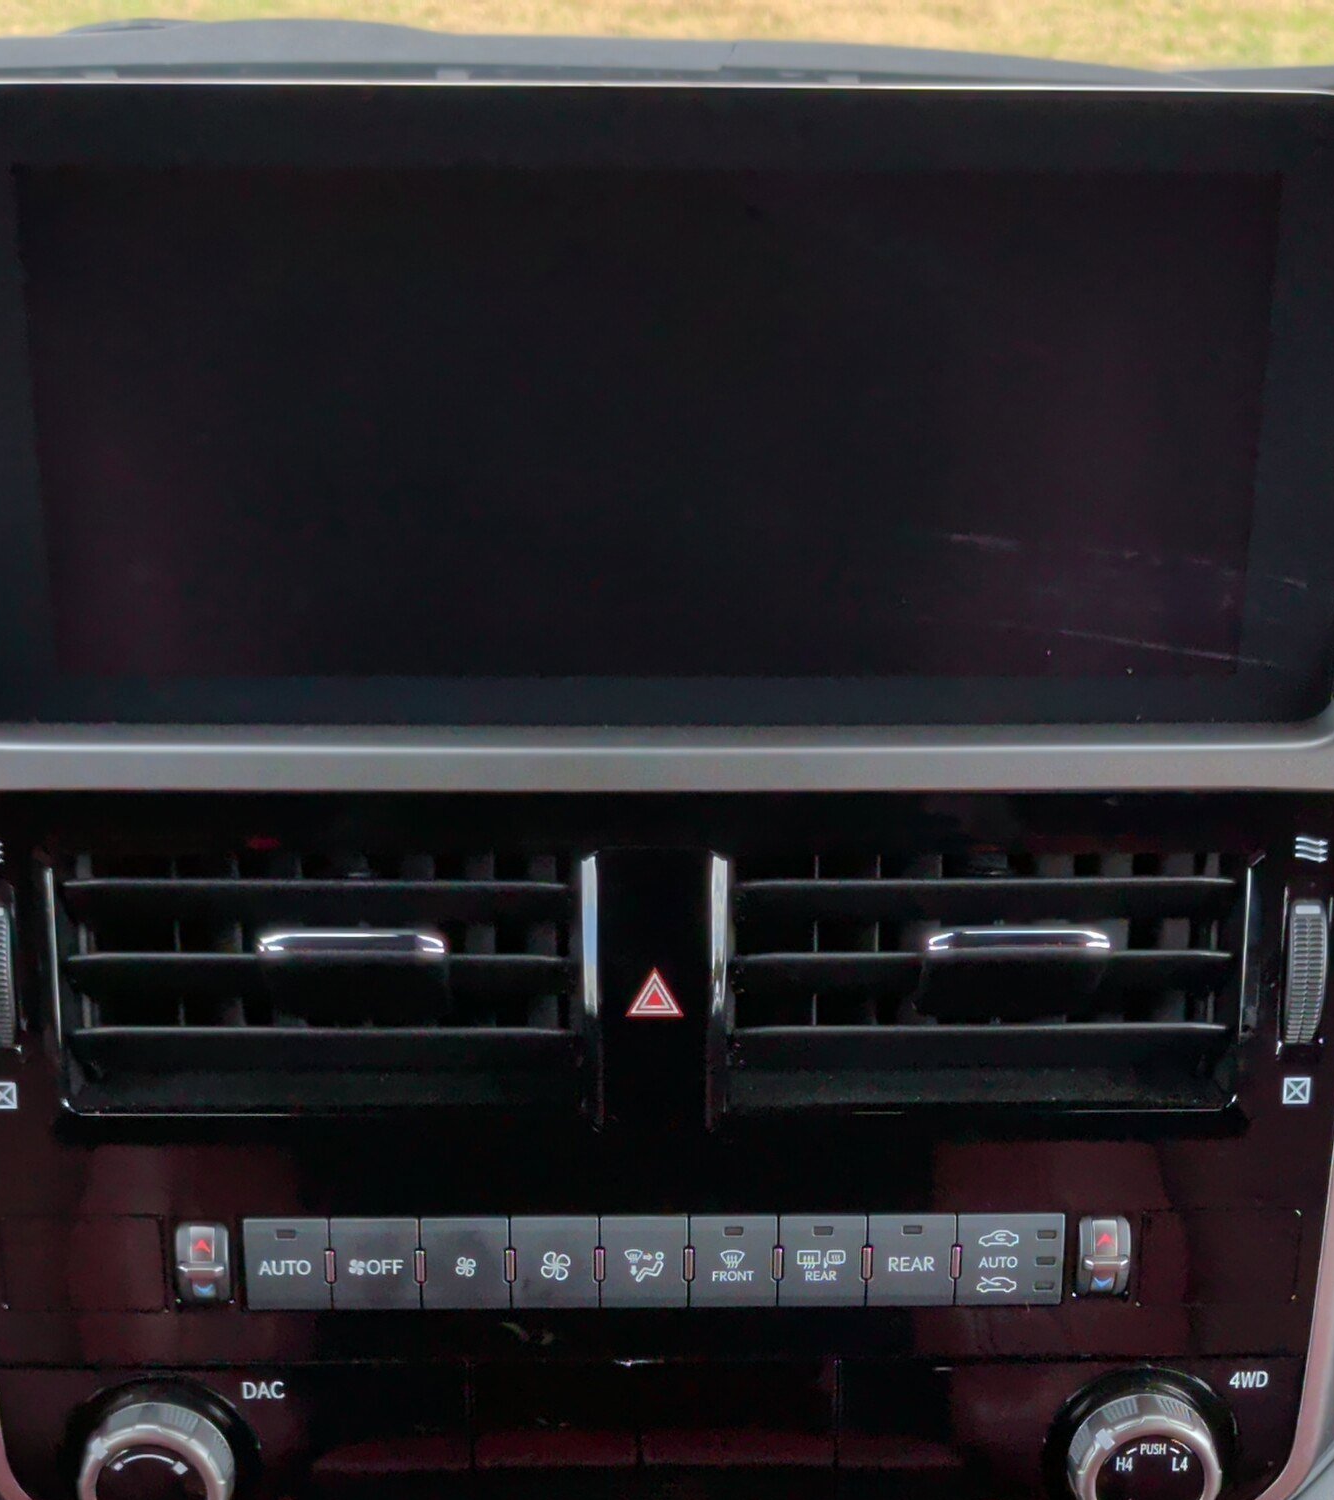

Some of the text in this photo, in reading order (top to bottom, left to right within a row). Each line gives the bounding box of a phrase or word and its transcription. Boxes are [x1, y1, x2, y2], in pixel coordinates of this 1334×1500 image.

[258, 1259, 312, 1276] AUTO
[366, 1259, 404, 1275] OFF
[887, 1255, 935, 1272] REAR
[978, 1256, 1018, 1269] AUTO
[711, 1270, 755, 1282] FRONT
[803, 1269, 837, 1282] REAR
[1229, 1370, 1269, 1389] 4WD
[241, 1380, 286, 1400] DAC
[1139, 1443, 1167, 1456] PUSH
[1115, 1457, 1134, 1472] H4
[1171, 1457, 1189, 1472] L4
